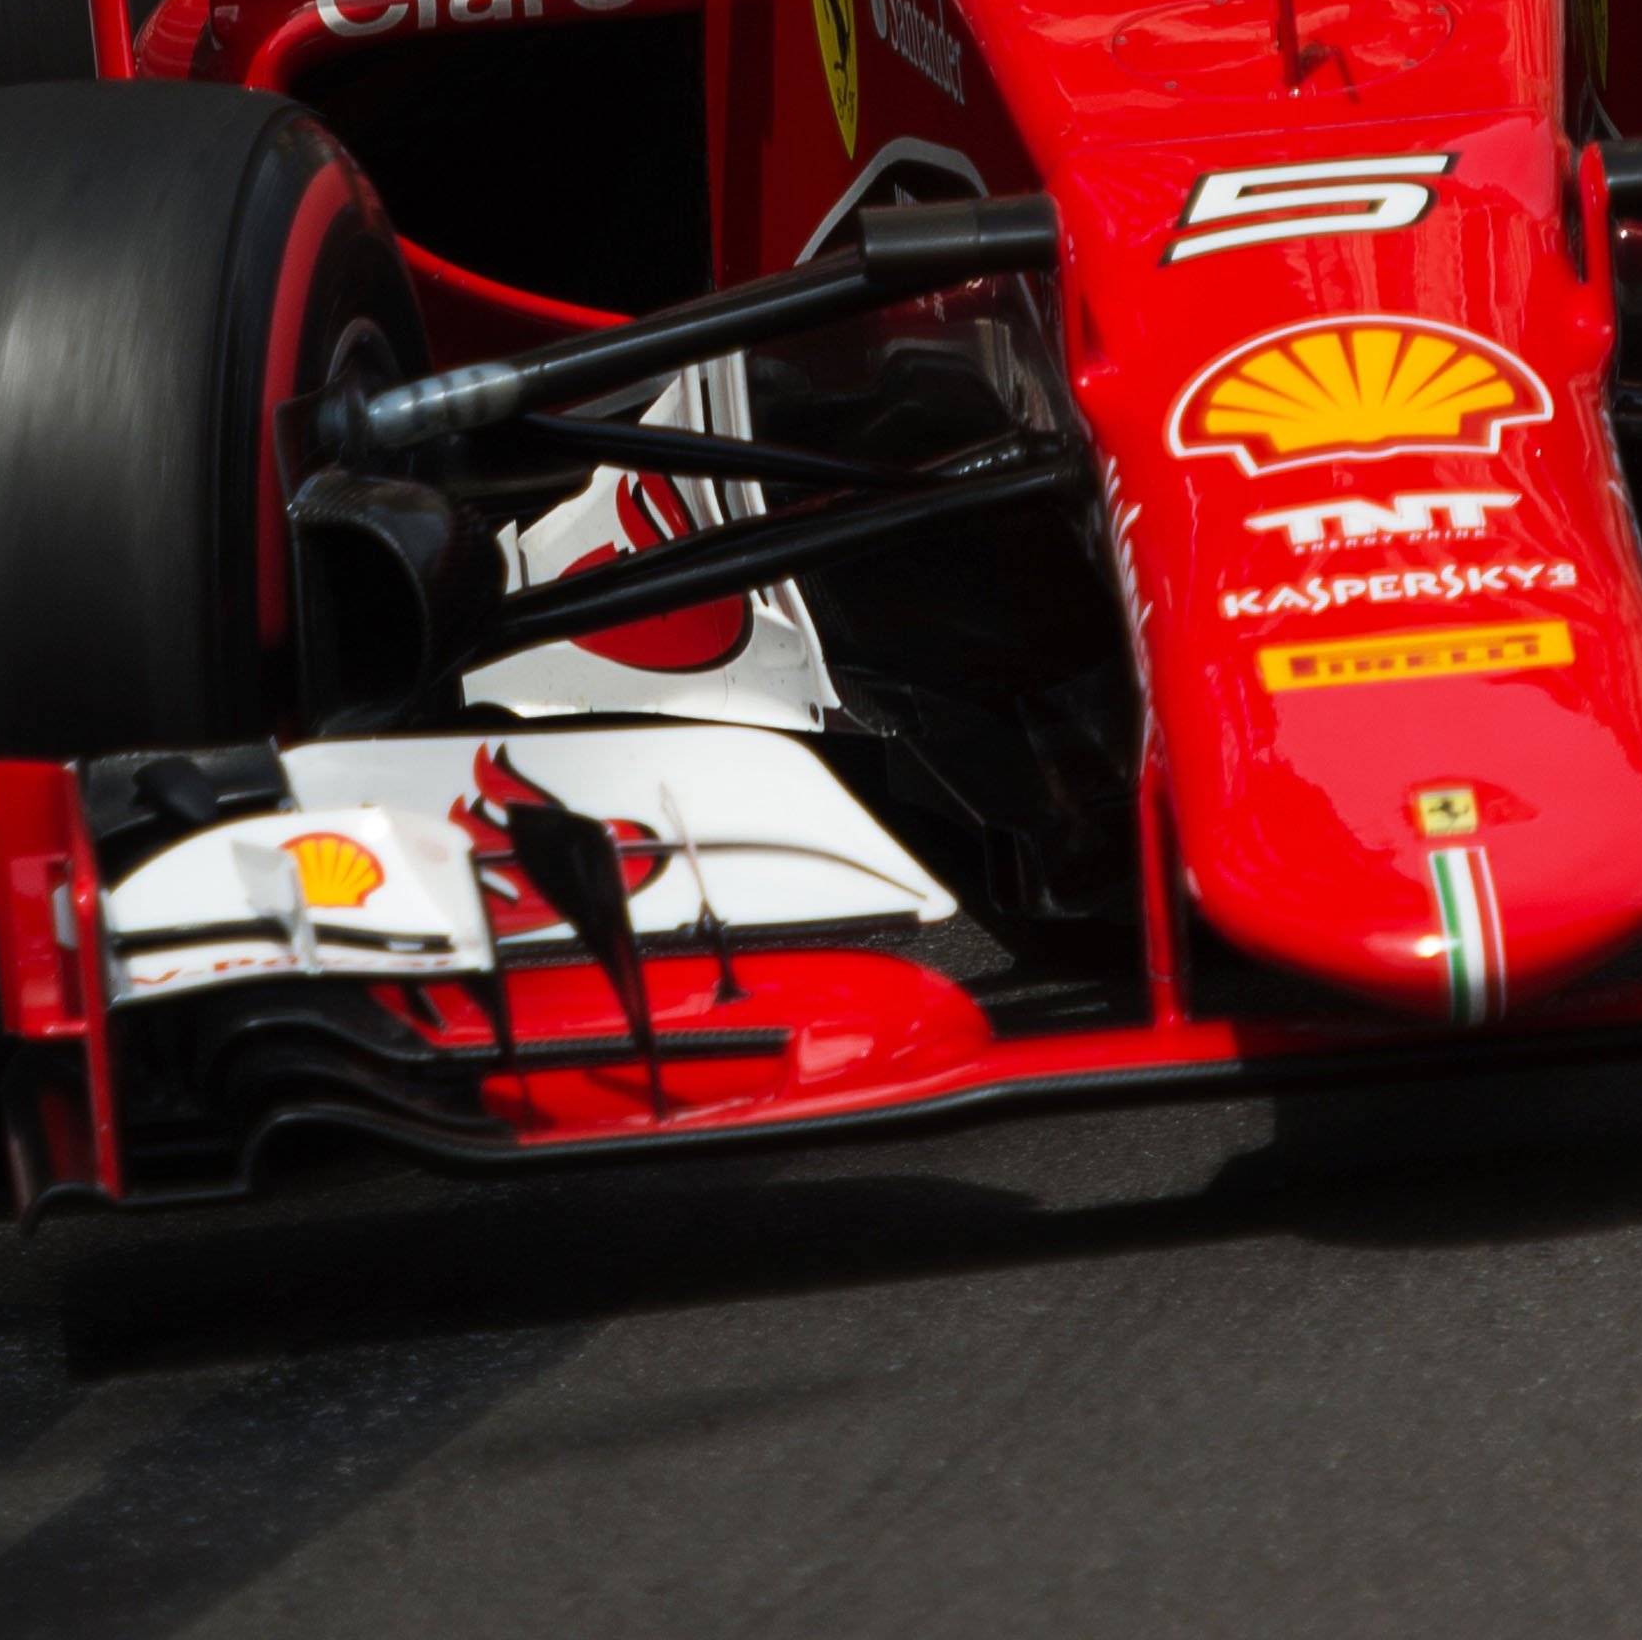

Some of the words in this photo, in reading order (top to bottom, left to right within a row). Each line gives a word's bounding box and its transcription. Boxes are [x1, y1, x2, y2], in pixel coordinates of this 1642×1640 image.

[1161, 152, 1461, 267] 5
[1244, 492, 1523, 545] TNT
[1222, 563, 1546, 619] KASPERSKY
